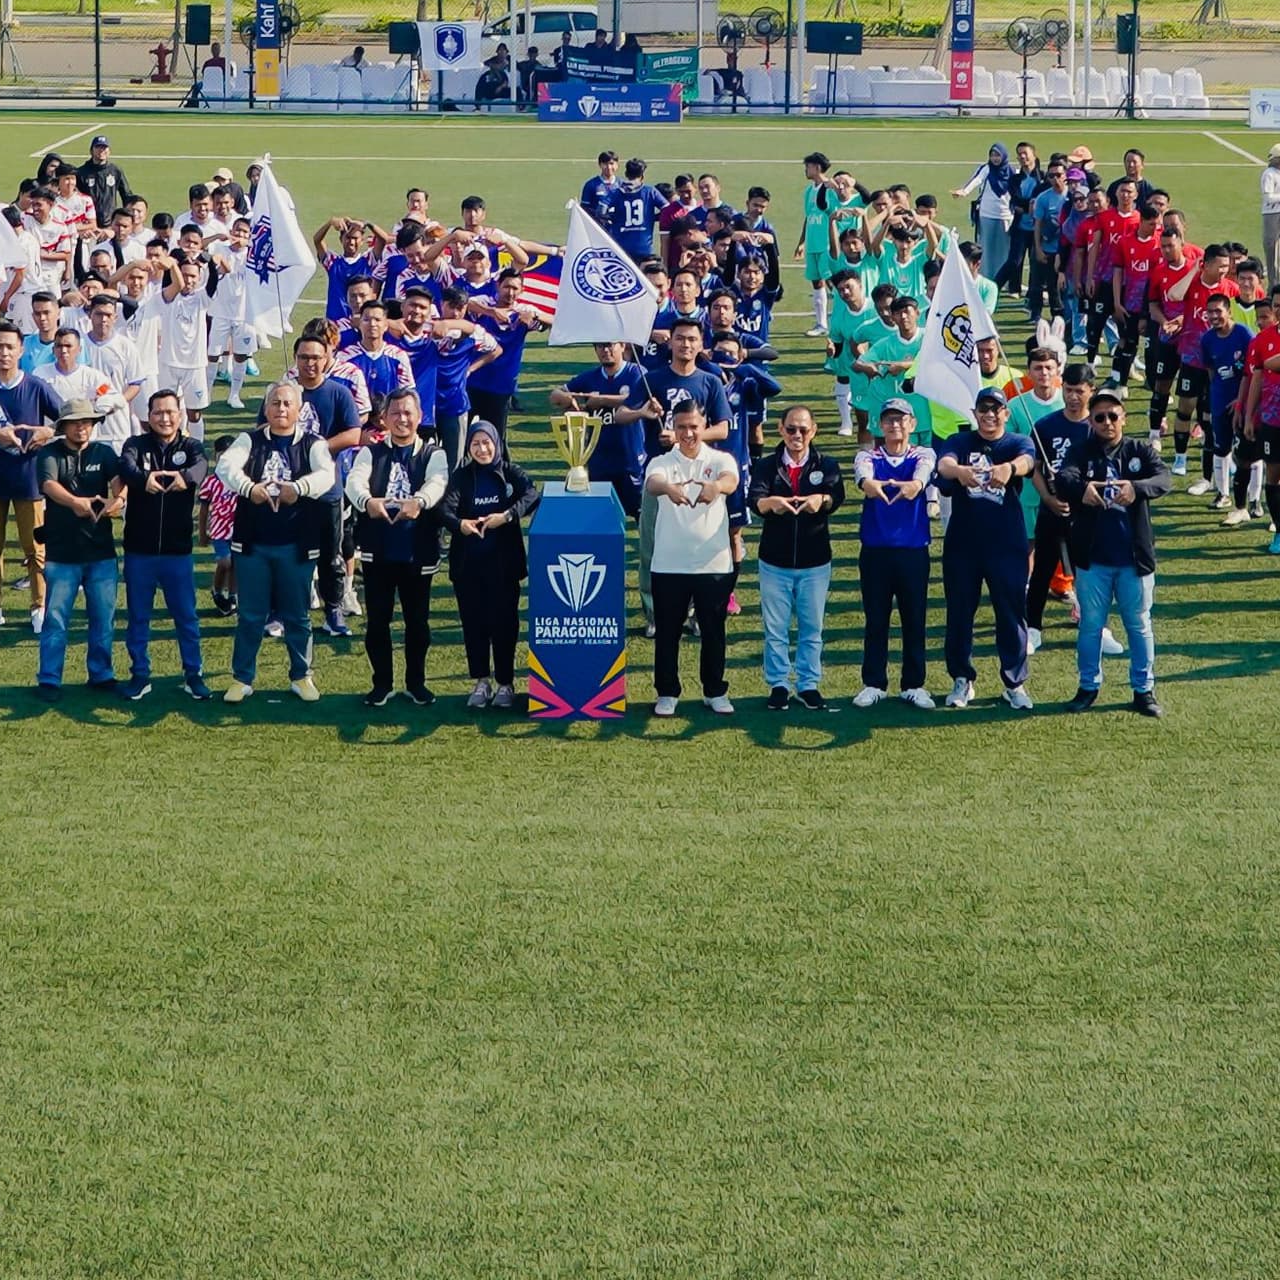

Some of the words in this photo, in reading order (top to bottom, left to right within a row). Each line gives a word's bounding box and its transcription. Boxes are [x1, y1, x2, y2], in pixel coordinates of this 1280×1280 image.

[260, 2, 275, 38] Kahf
[624, 199, 644, 227] 13
[1157, 361, 1164, 374] 6
[535, 617, 560, 626] LIGA
[563, 617, 618, 626] NASIONAL
[535, 626, 618, 638] PARAGONIAN
